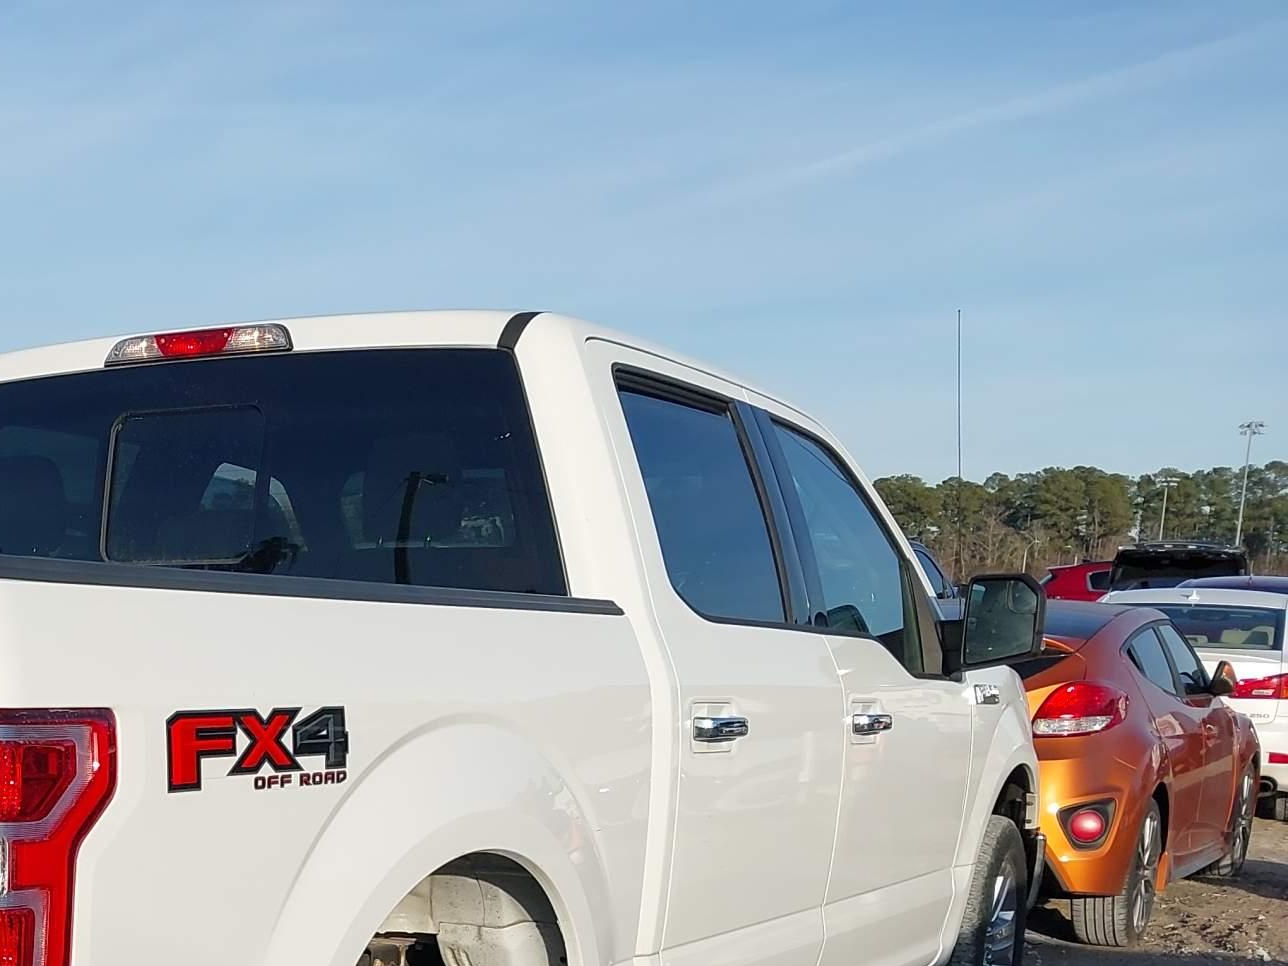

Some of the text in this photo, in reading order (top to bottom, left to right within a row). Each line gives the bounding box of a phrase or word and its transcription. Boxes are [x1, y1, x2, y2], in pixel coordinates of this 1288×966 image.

[166, 706, 349, 793] FX4
[254, 770, 347, 790] OFF ROAD
